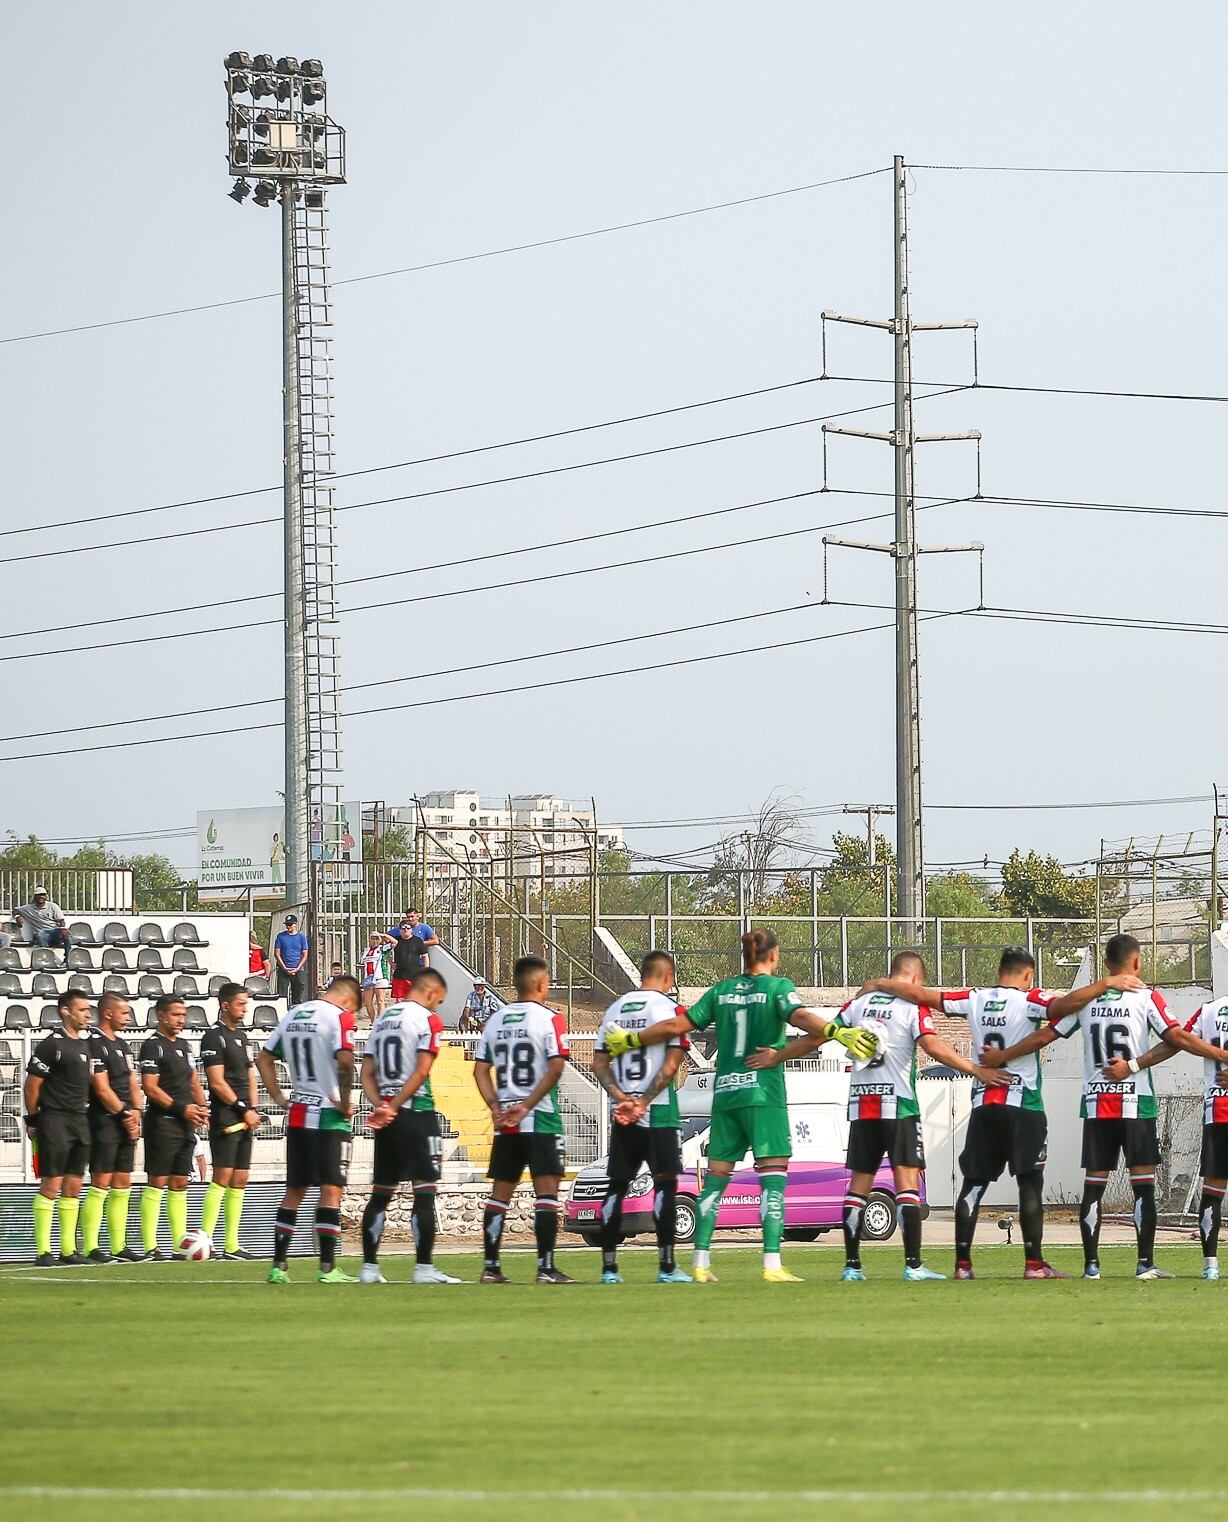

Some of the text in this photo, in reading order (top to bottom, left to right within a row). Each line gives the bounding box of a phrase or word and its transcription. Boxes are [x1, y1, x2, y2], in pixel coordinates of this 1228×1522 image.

[202, 858, 252, 869] EN COMUNIDAD
[202, 870, 264, 882] POR UN BUEN VIVIR
[862, 1008, 892, 1020] FARIAS
[1091, 1008, 1130, 1018] BIZAMA
[982, 1016, 1006, 1026] SALAS
[736, 1009, 748, 1057] 1
[1090, 1024, 1131, 1068] 16
[291, 1038, 316, 1081] 11
[494, 1043, 535, 1088] 28
[850, 1085, 893, 1096] KAYSER
[1088, 1083, 1132, 1094] KAYSER
